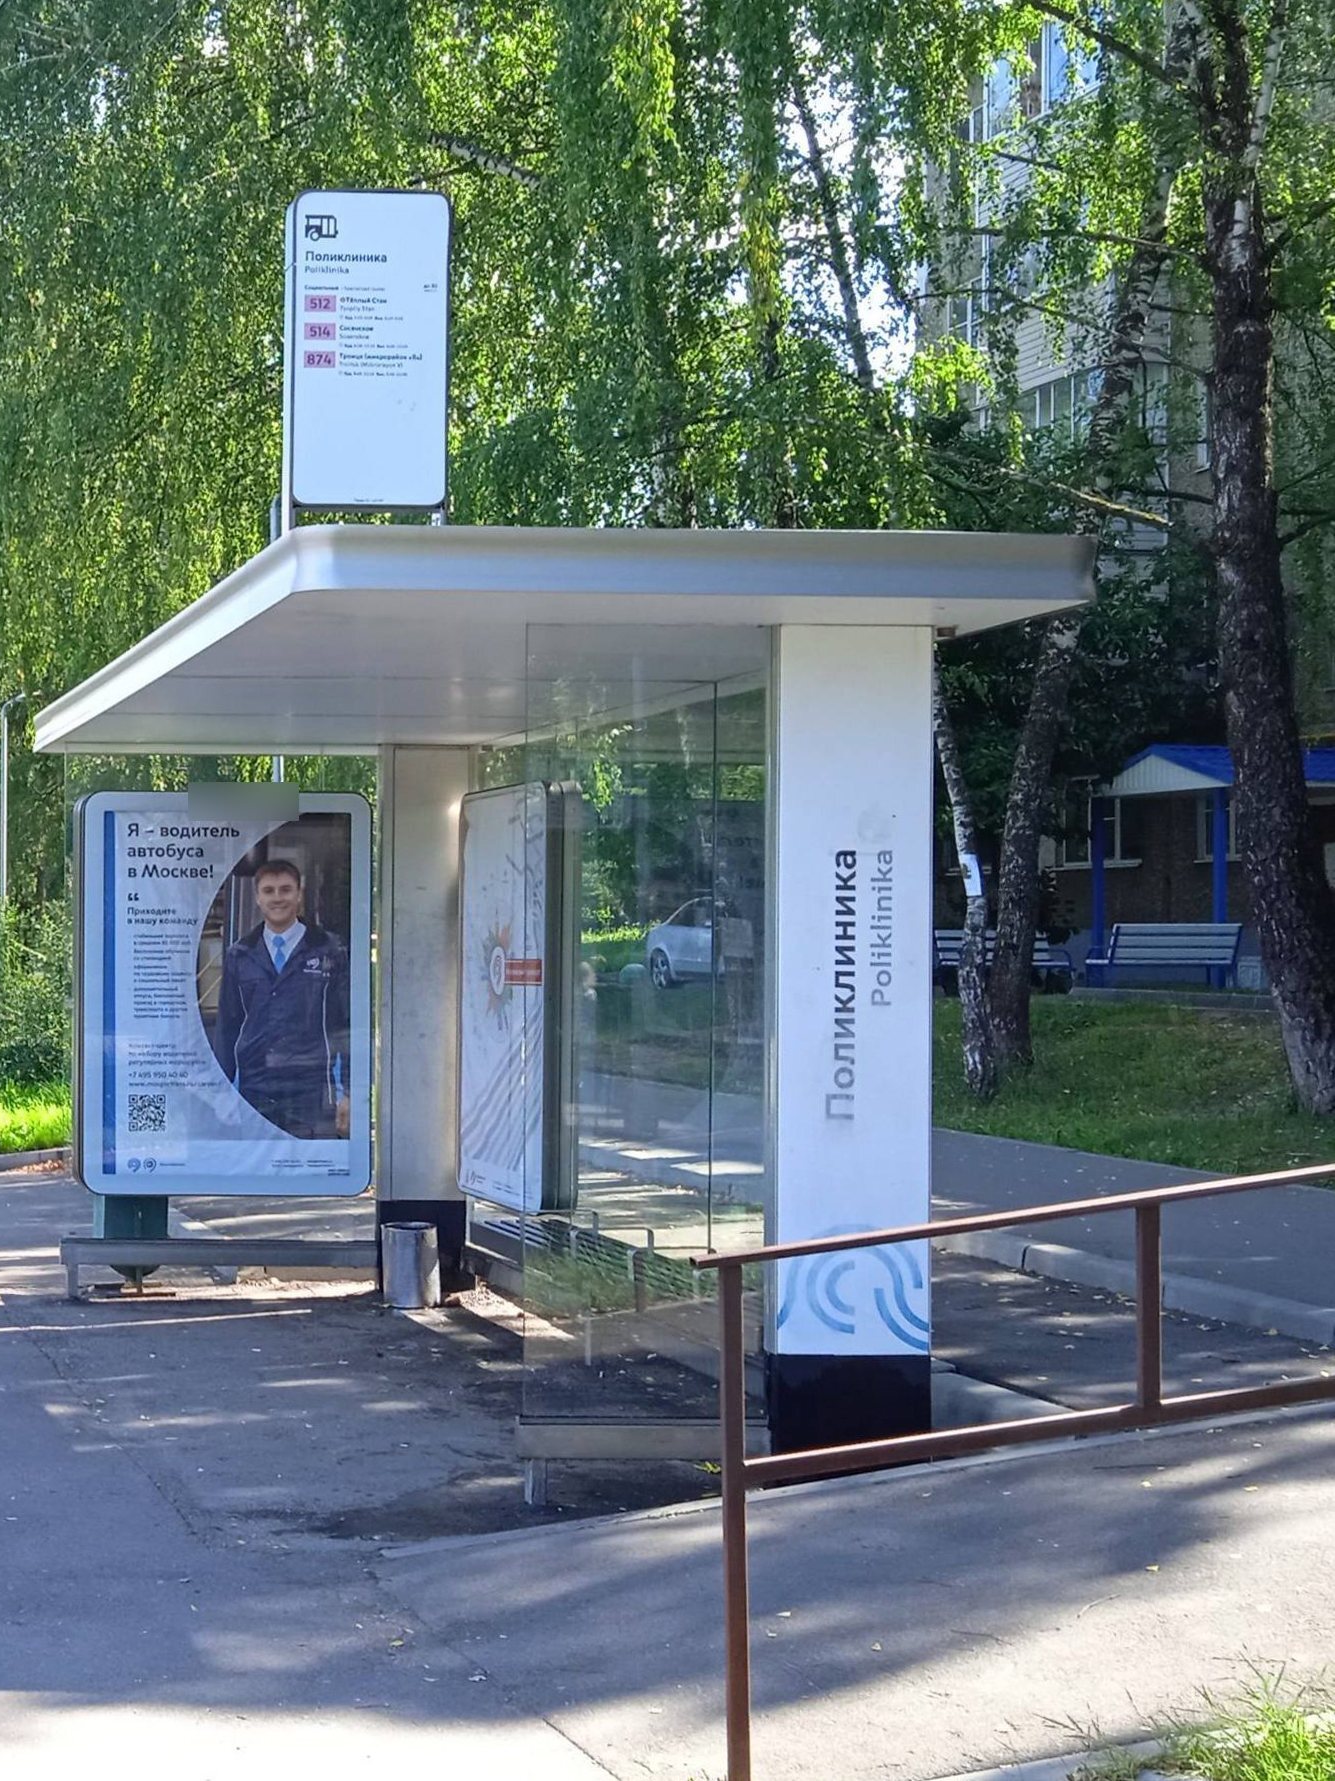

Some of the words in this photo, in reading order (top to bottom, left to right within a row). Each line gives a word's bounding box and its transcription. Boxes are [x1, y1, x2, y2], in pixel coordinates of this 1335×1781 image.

[305, 250, 388, 263] Поликлиника
[304, 265, 350, 274] Poliklinika
[309, 298, 331, 310] 512
[309, 326, 330, 338] 514
[306, 354, 332, 366] 874
[127, 823, 139, 837] Я
[160, 826, 240, 839] водитель
[127, 843, 205, 861] автобуса
[127, 867, 137, 878] в
[141, 864, 214, 879] Москве!
[127, 906, 177, 916] Приходите
[134, 918, 157, 926] нашу
[159, 918, 198, 926] команду
[870, 850, 893, 1006] Poliklinika
[825, 850, 857, 1120] Поликлиника
